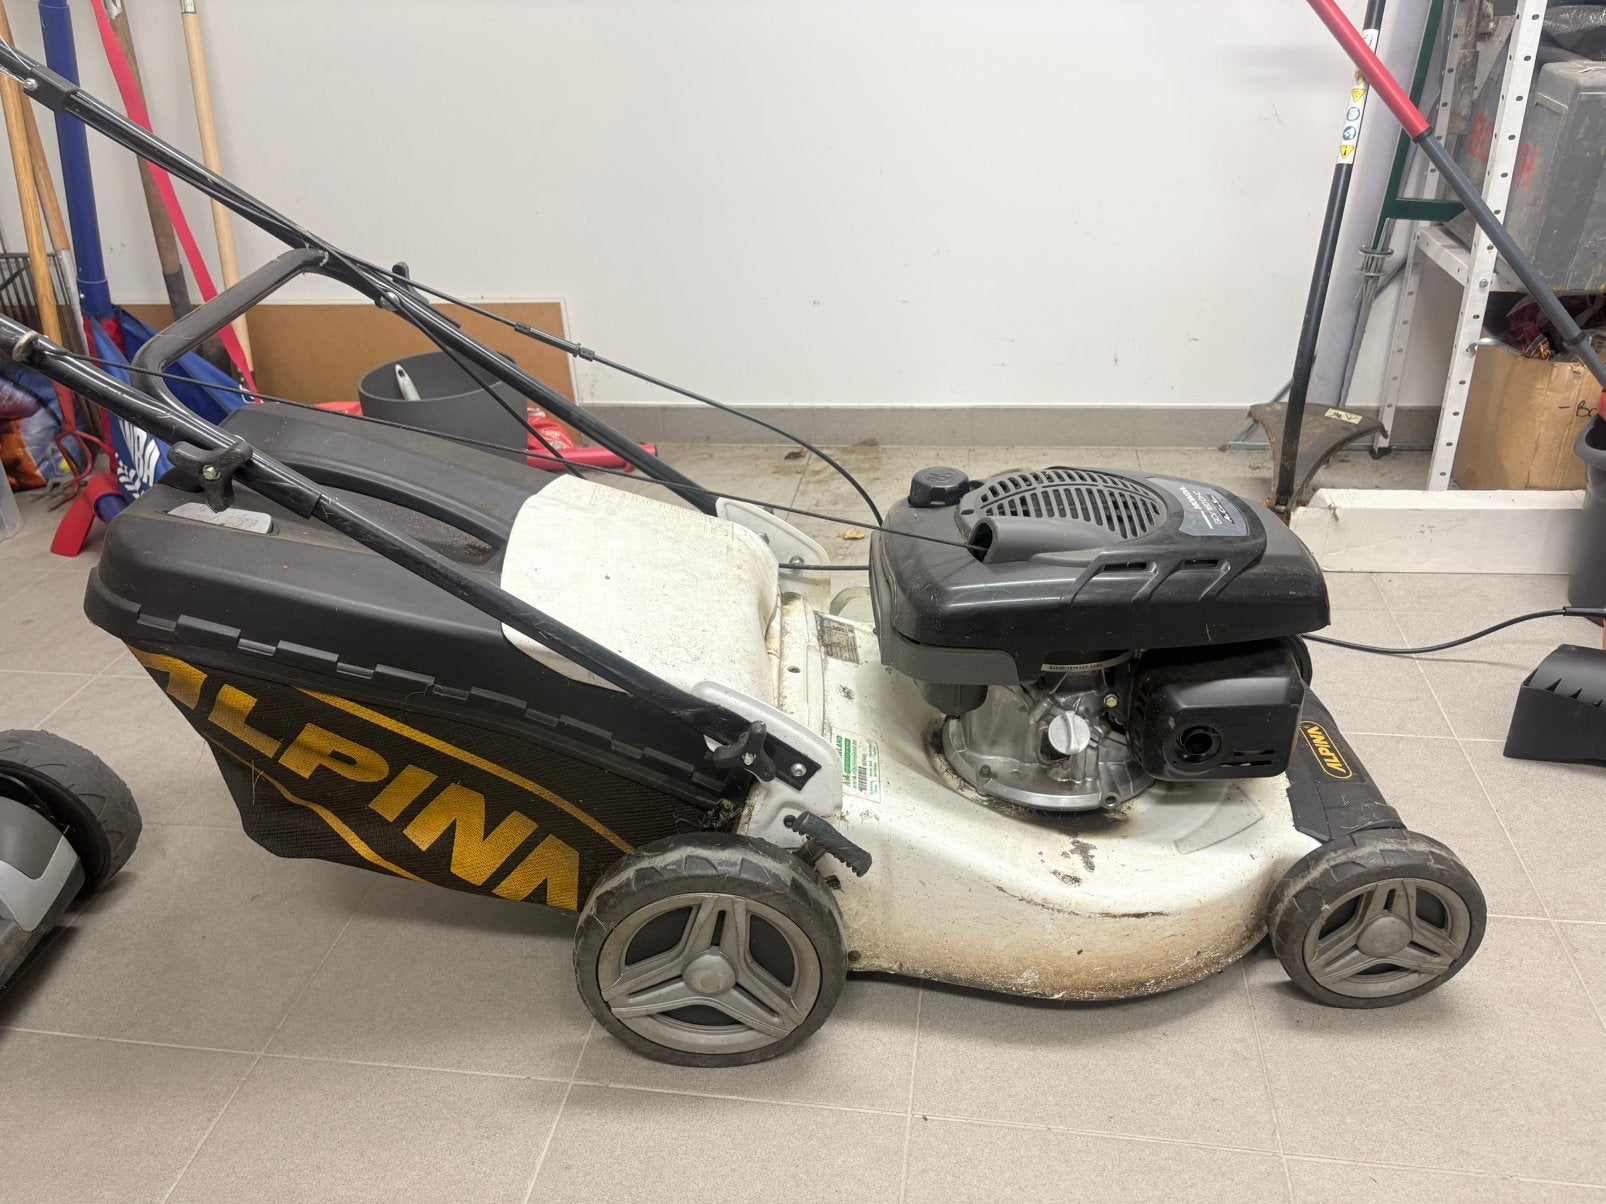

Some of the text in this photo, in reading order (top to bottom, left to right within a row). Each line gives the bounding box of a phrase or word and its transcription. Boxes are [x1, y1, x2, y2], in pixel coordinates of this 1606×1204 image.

[1180, 485, 1202, 510] HONDA
[1306, 725, 1347, 775] ALPINA
[129, 646, 580, 912] ALPINA
